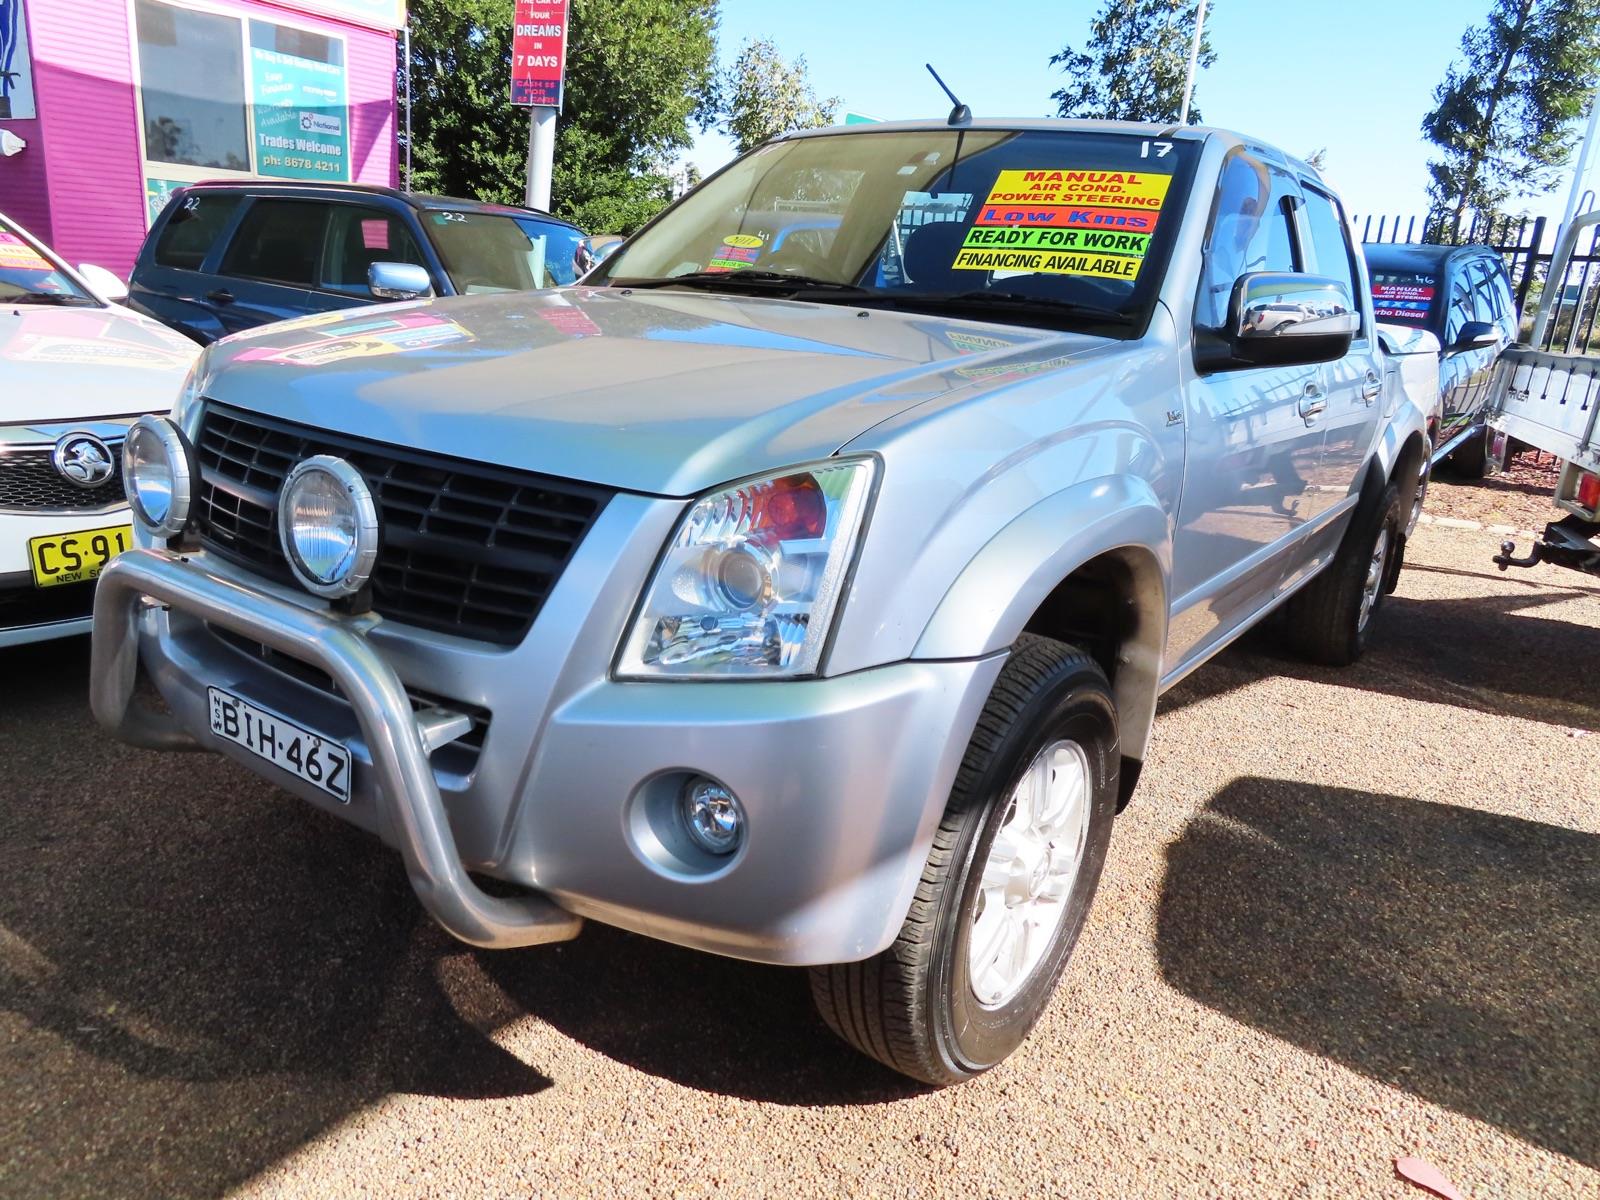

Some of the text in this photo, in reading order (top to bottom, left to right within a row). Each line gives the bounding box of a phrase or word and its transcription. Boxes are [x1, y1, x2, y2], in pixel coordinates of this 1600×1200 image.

[530, 11, 550, 19] YOUR
[517, 24, 562, 37] DREAMS
[533, 42, 542, 50] IN
[517, 55, 558, 67] 7 DAYS
[259, 133, 342, 156] Trades Welcome
[1140, 141, 1176, 159] 17
[263, 155, 340, 172] ph: 8678 4211
[1023, 171, 1143, 185] MANUAL
[1029, 183, 1127, 194] AIR COND.
[183, 197, 201, 211] 22
[990, 193, 1161, 207] POWER STEERING
[442, 212, 467, 223] 22
[983, 209, 1148, 228] Low Kms
[968, 230, 1145, 252] READY FOR WORK
[957, 252, 1136, 277] FINANCING AVAILABLE
[1394, 310, 1425, 319] Diesel
[56, 571, 82, 583] NEW
